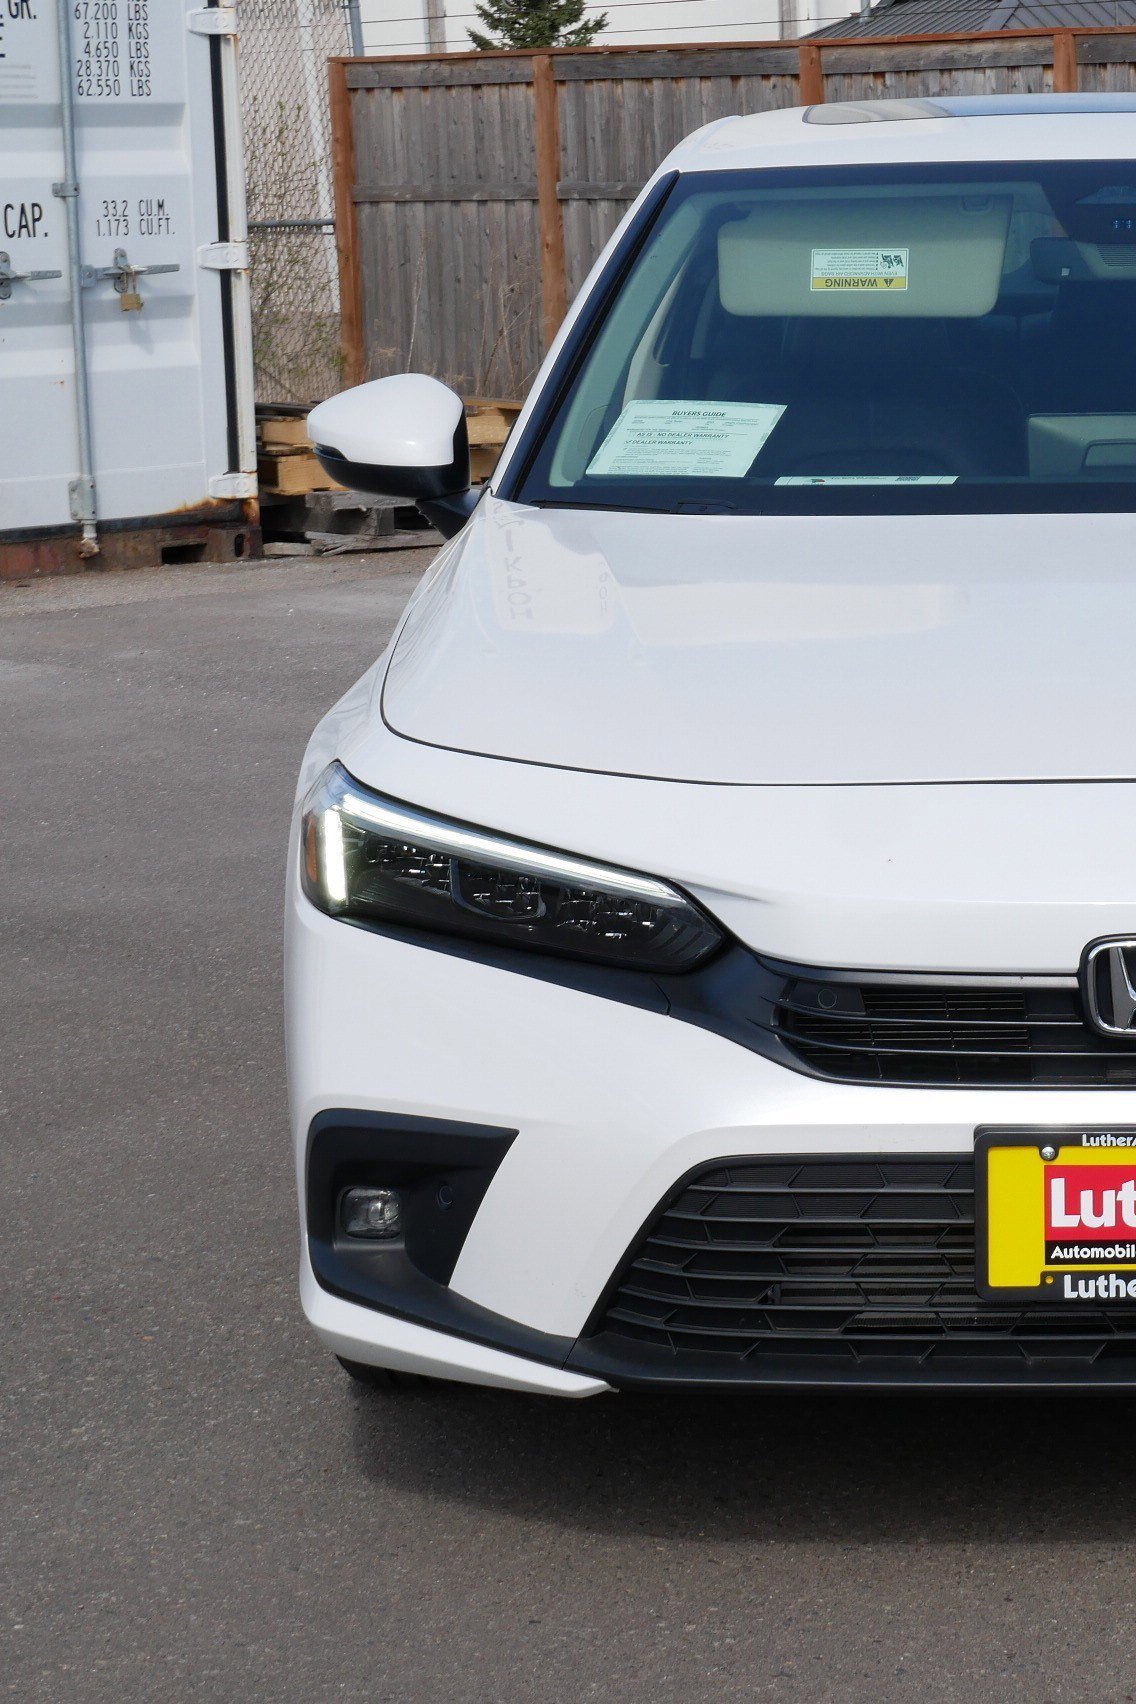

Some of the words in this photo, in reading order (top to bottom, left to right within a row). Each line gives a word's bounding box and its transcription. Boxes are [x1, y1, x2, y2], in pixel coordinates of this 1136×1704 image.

[74, 2, 118, 20] 67.200
[127, 3, 149, 21] LBS
[83, 21, 118, 39] 2.110
[128, 22, 150, 39] KGS
[84, 41, 119, 58] 4.650
[128, 41, 150, 58] LBS
[77, 60, 120, 77] 28.370
[130, 60, 151, 77] KGS
[77, 79, 121, 96] 62.550
[130, 79, 152, 97] LBS
[102, 200, 129, 218] 33.2
[4, 202, 48, 238] CAP.
[96, 218, 130, 236] 1.173
[824, 278, 878, 288] WARNING
